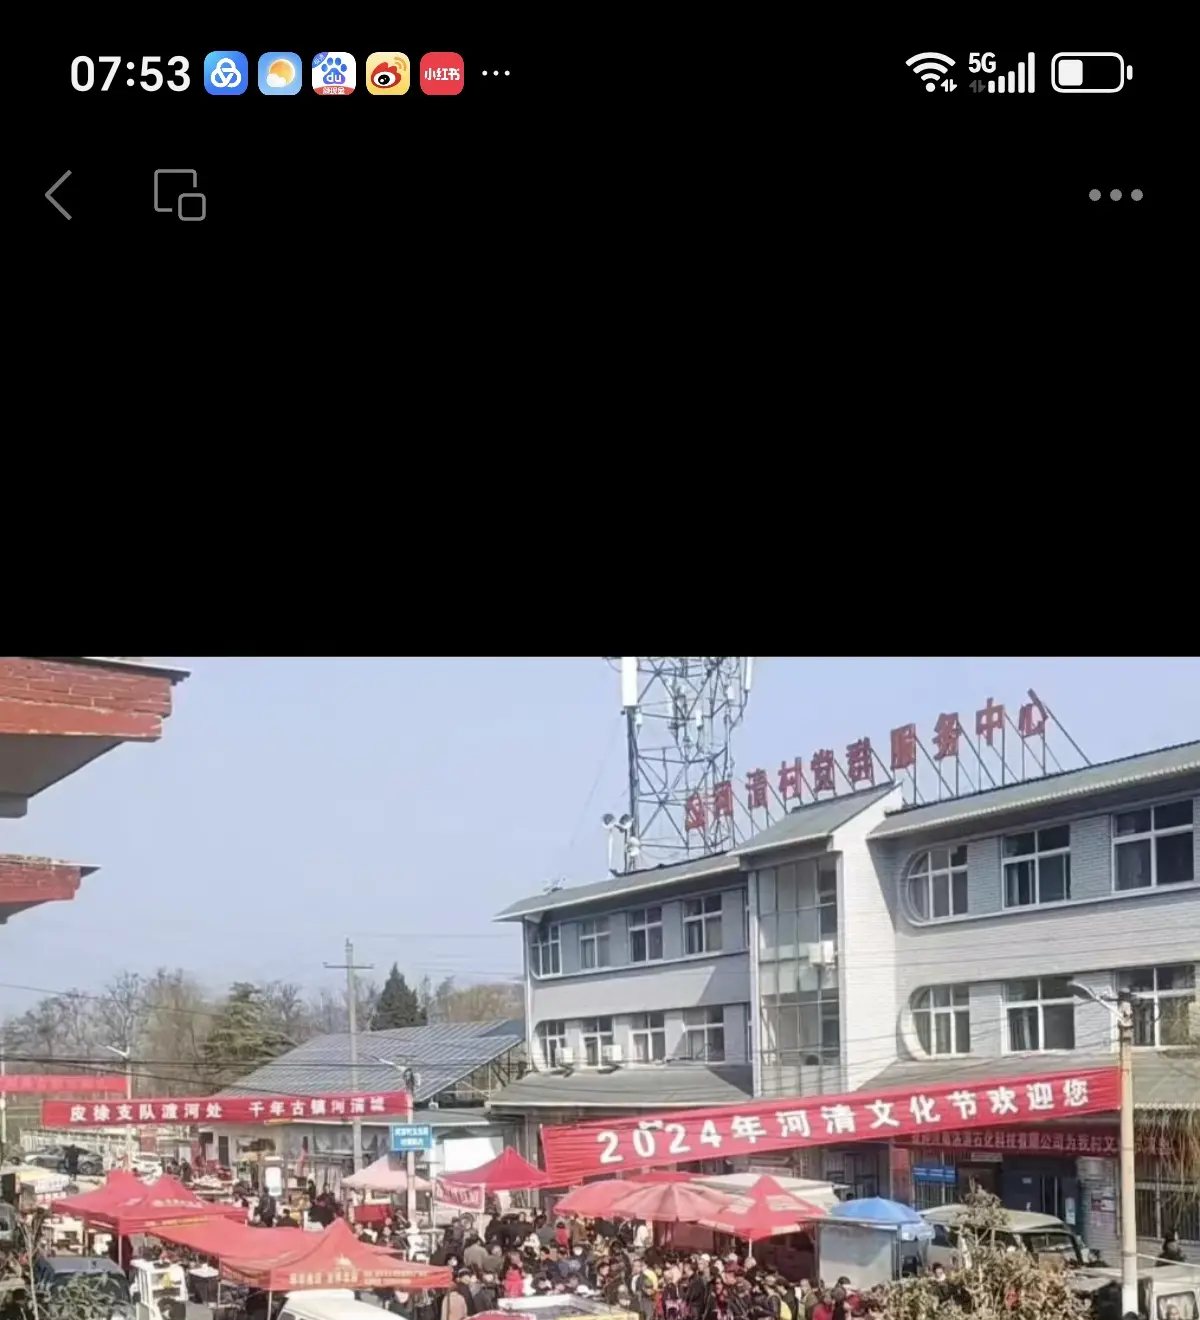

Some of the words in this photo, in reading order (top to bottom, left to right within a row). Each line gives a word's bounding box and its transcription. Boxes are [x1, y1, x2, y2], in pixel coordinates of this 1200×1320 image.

[596, 1079, 1089, 1164] 2024年河清文化节欢迎您
